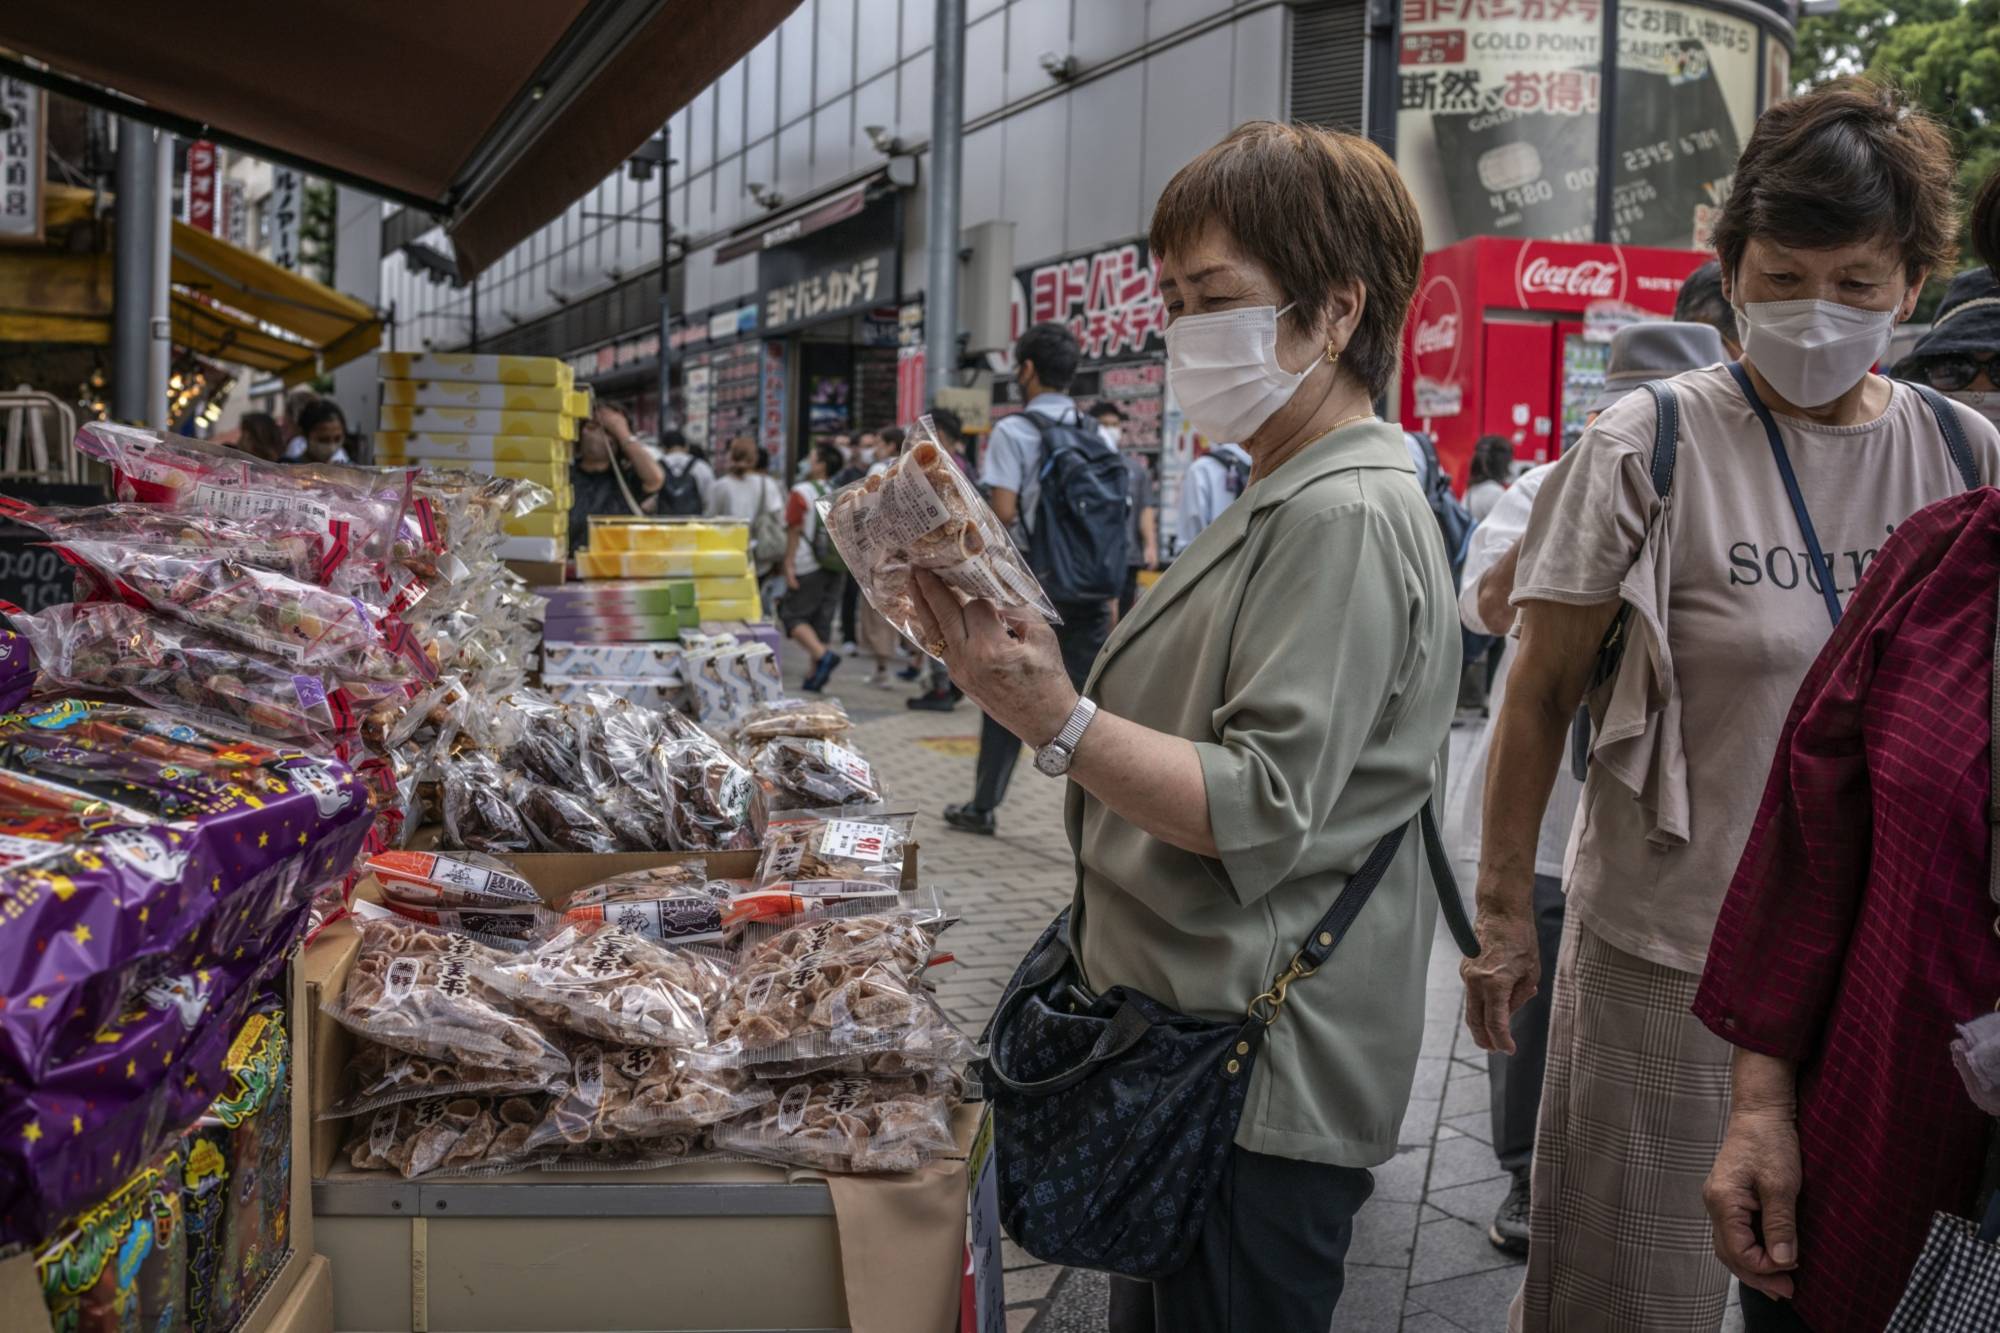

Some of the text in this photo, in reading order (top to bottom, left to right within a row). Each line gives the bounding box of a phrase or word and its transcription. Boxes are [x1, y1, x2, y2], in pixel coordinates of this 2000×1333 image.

[1471, 31, 1526, 51] GOLD
[1536, 33, 1598, 52] POINT
[1489, 179, 1554, 213] 4980
[1622, 140, 1675, 172] 2345
[276, 171, 296, 268] ルノアール
[765, 256, 880, 328] ヨドバシカメラ
[1034, 247, 1164, 323] ヨドバシ
[1522, 256, 1619, 297] Coca-Cola
